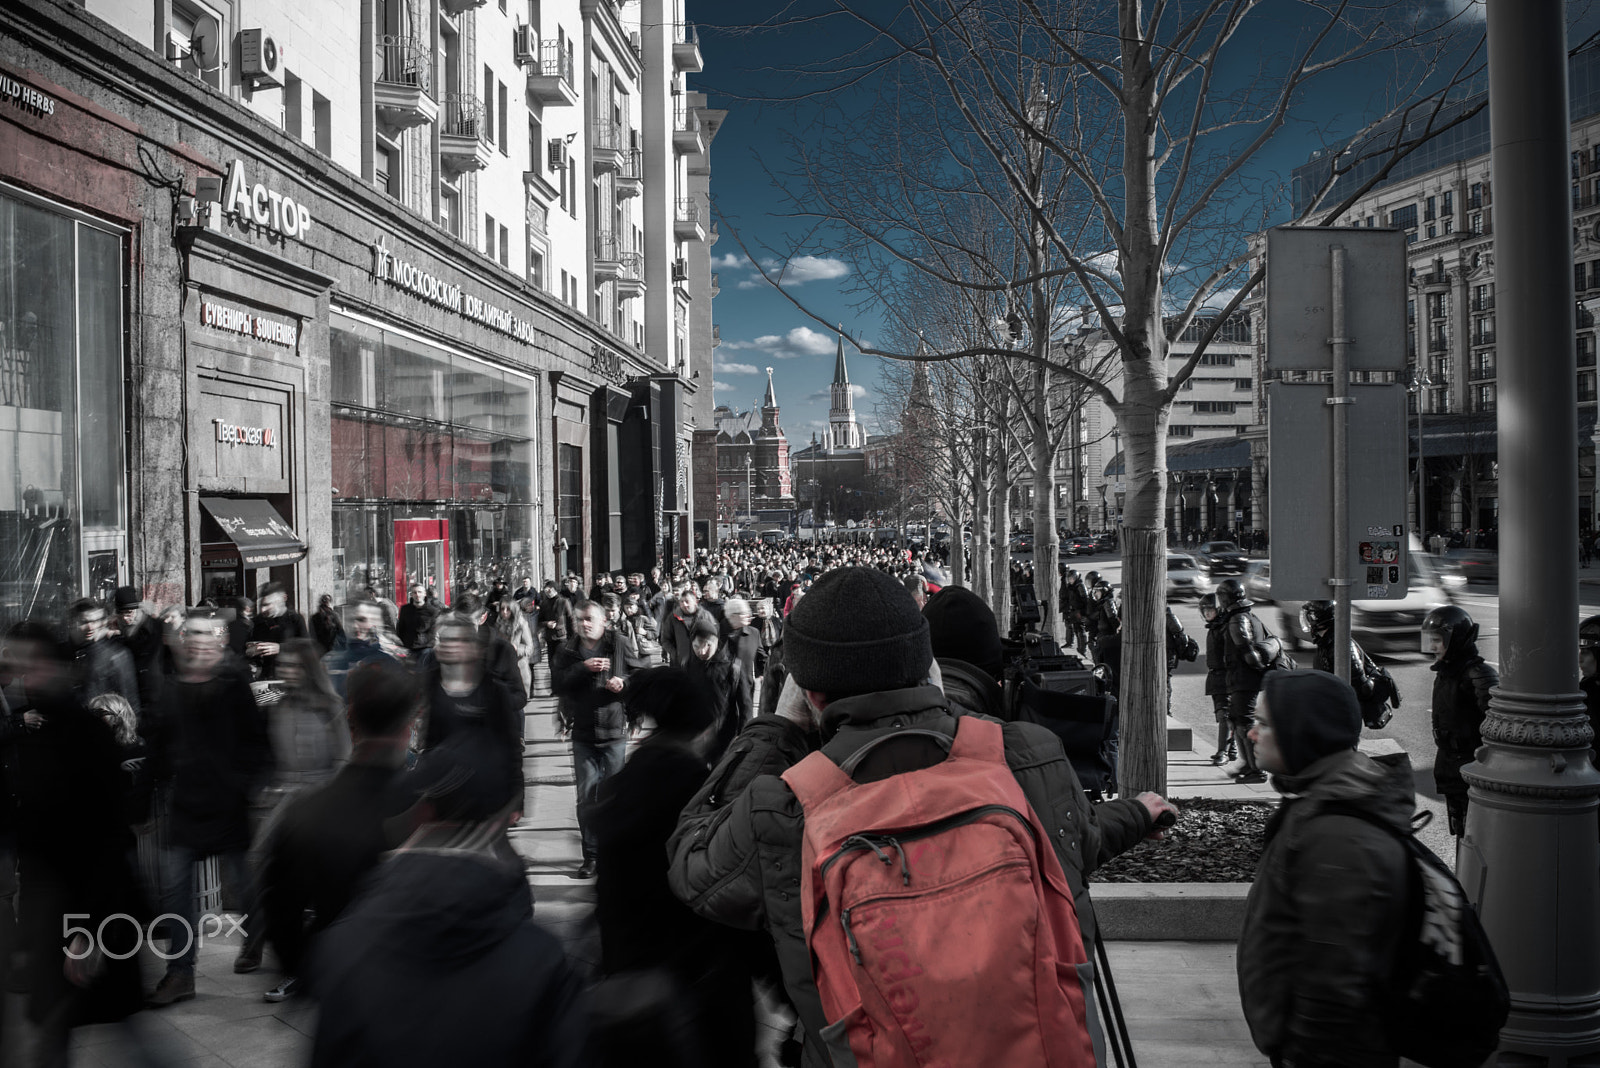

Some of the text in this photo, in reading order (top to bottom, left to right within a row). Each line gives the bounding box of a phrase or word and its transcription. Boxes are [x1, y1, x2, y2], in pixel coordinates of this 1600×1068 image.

[22, 86, 55, 115] HERBS
[393, 257, 535, 344] МОСКОВСКИЙ ЮВЕЛИРНЫЙ ЗАВОД
[205, 301, 253, 334] СУВЕНИРЫ
[256, 316, 297, 346] SOUVENIRS
[215, 418, 263, 448] Тверская
